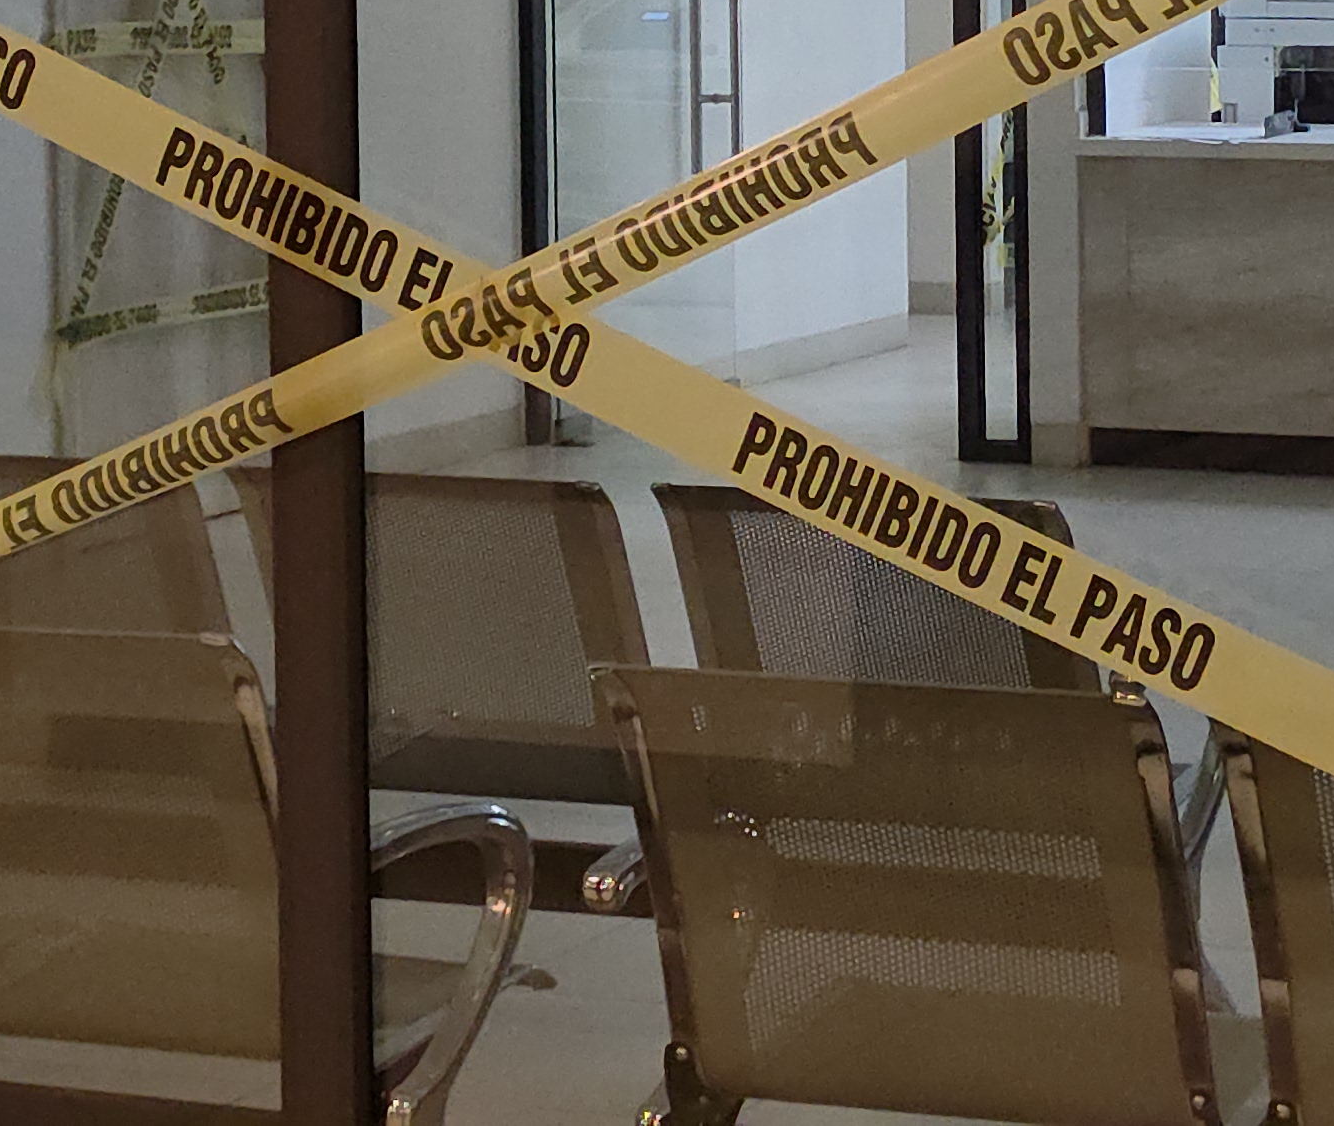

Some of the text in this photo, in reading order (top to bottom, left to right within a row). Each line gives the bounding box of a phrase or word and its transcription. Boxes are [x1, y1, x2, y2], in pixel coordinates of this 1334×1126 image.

[155, 127, 398, 292] PROHIBIDO
[732, 412, 1216, 691] PROHIBIDO EL PASO
